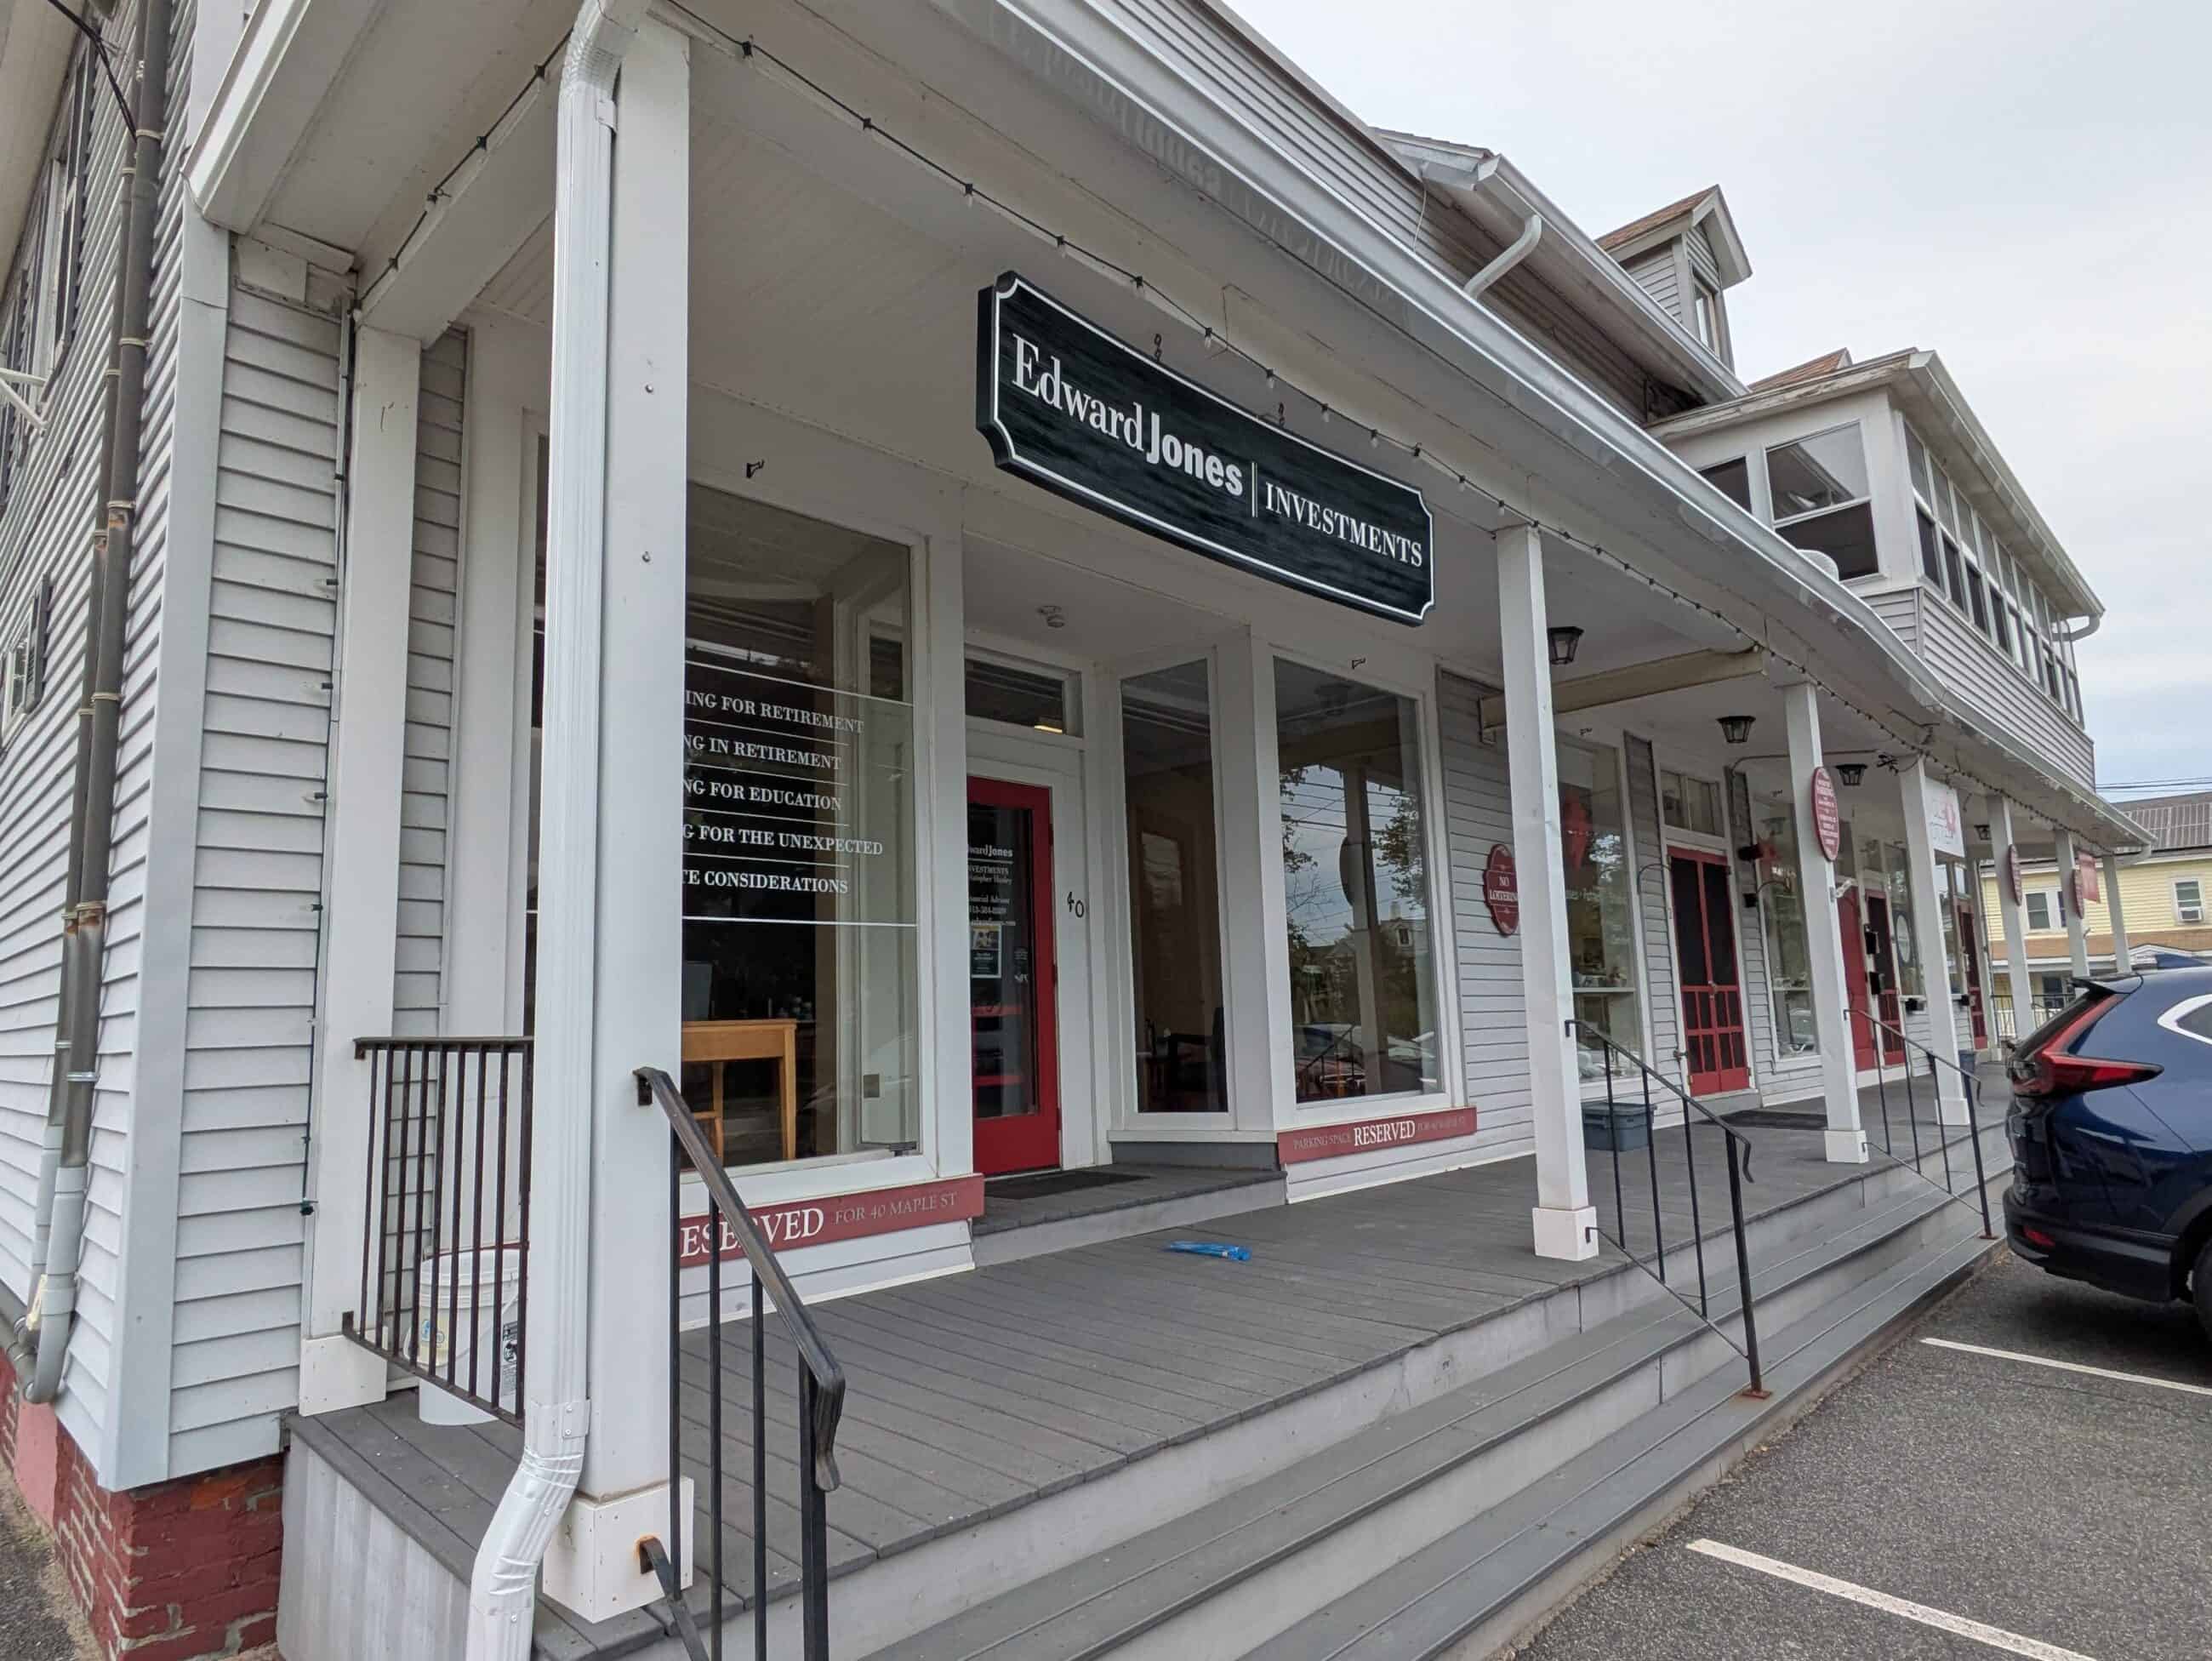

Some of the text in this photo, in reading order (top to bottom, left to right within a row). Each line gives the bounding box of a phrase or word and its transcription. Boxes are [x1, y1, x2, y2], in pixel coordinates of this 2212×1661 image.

[1265, 482, 1423, 568] INVESTMENTS
[721, 695, 756, 716] FOR
[761, 703, 864, 733] RETIREMENT
[710, 737, 729, 755] IN
[734, 740, 842, 770] RETIREMENT
[710, 781, 745, 801] FOR
[750, 786, 842, 811] EDUCATION
[698, 825, 735, 843] FOR
[738, 829, 775, 847] THE
[778, 832, 883, 856] UNEXPECTED
[704, 870, 848, 894] CONSIDERATIONS
[1067, 892, 1085, 918] 40
[1354, 1120, 1416, 1146] RESERVED
[680, 1192, 958, 1259] ESEVED FOR 40 MAPLE ST
